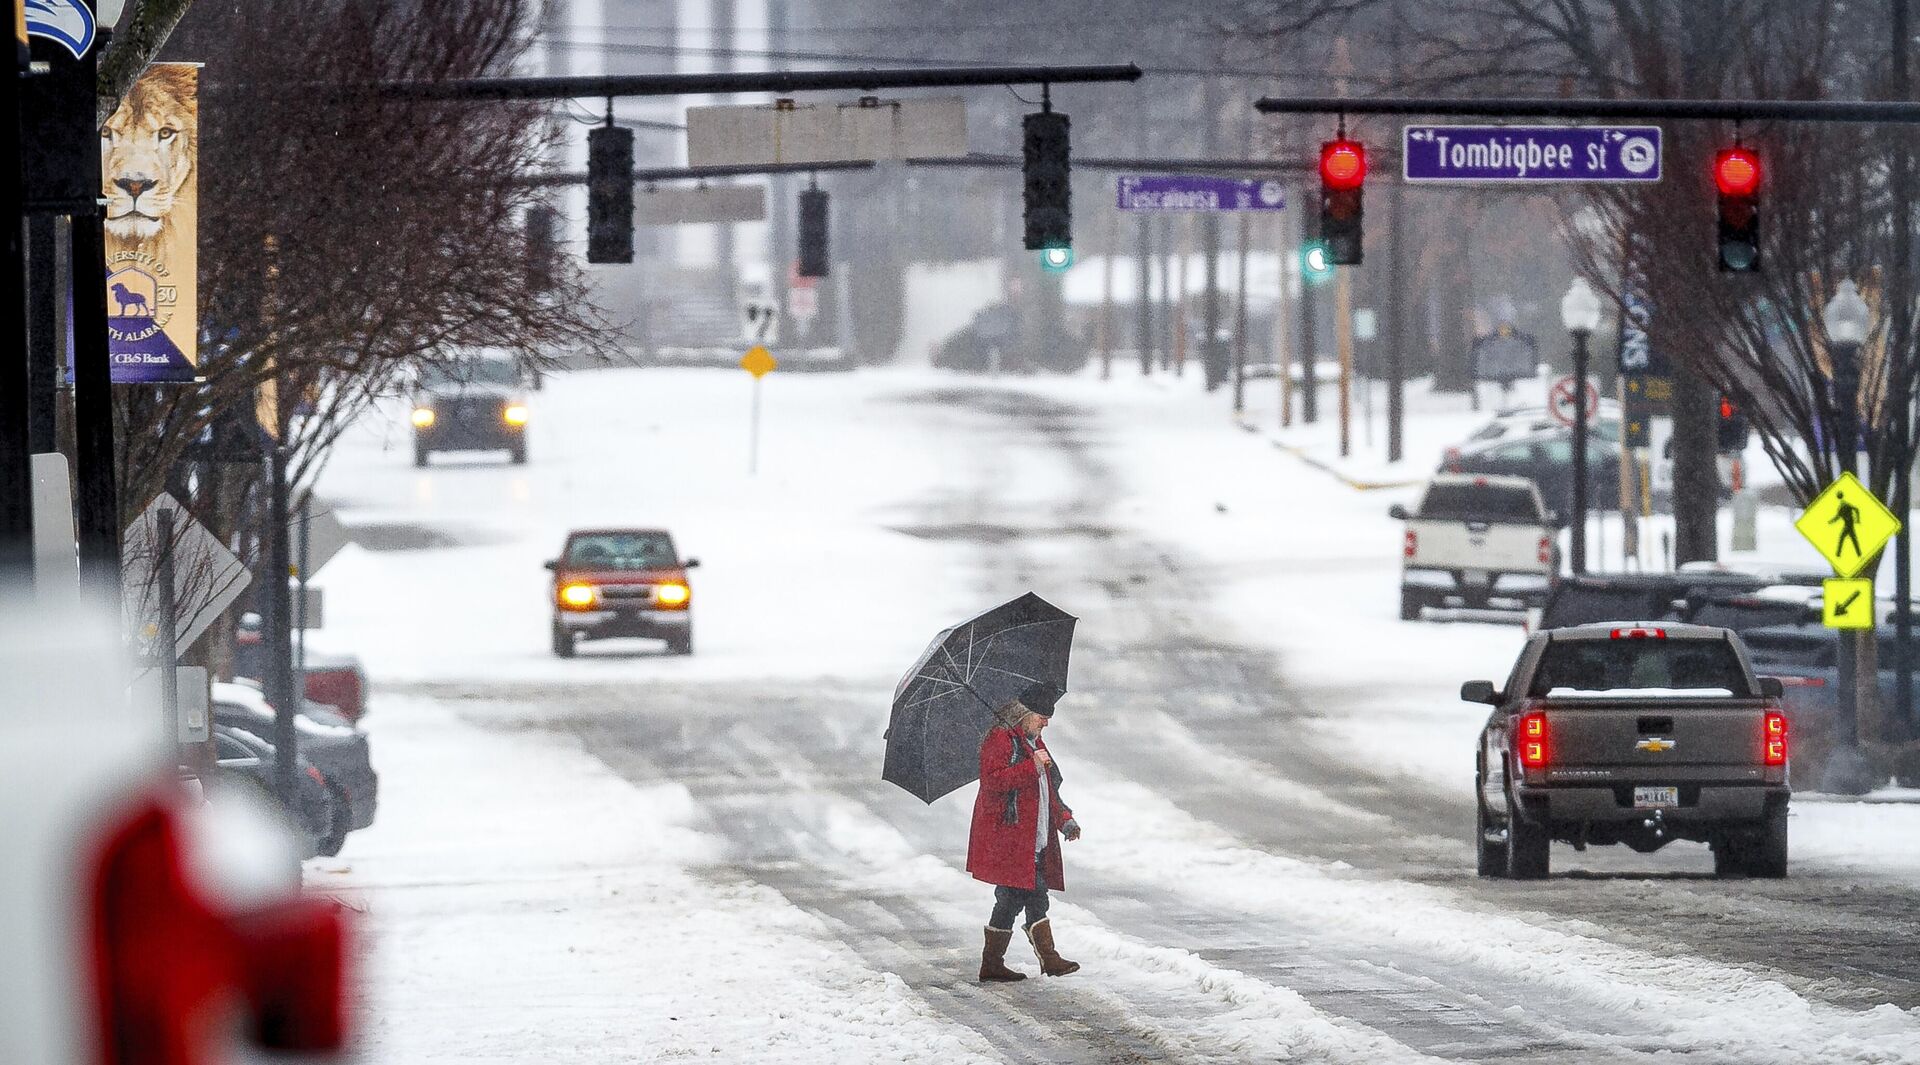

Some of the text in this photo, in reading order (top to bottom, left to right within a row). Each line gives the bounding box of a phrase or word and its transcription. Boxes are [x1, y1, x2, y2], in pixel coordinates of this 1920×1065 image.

[1437, 136, 1607, 176] Tombigbee St
[155, 263, 170, 278] OF
[158, 287, 177, 303] 30
[143, 353, 170, 364] Bank
